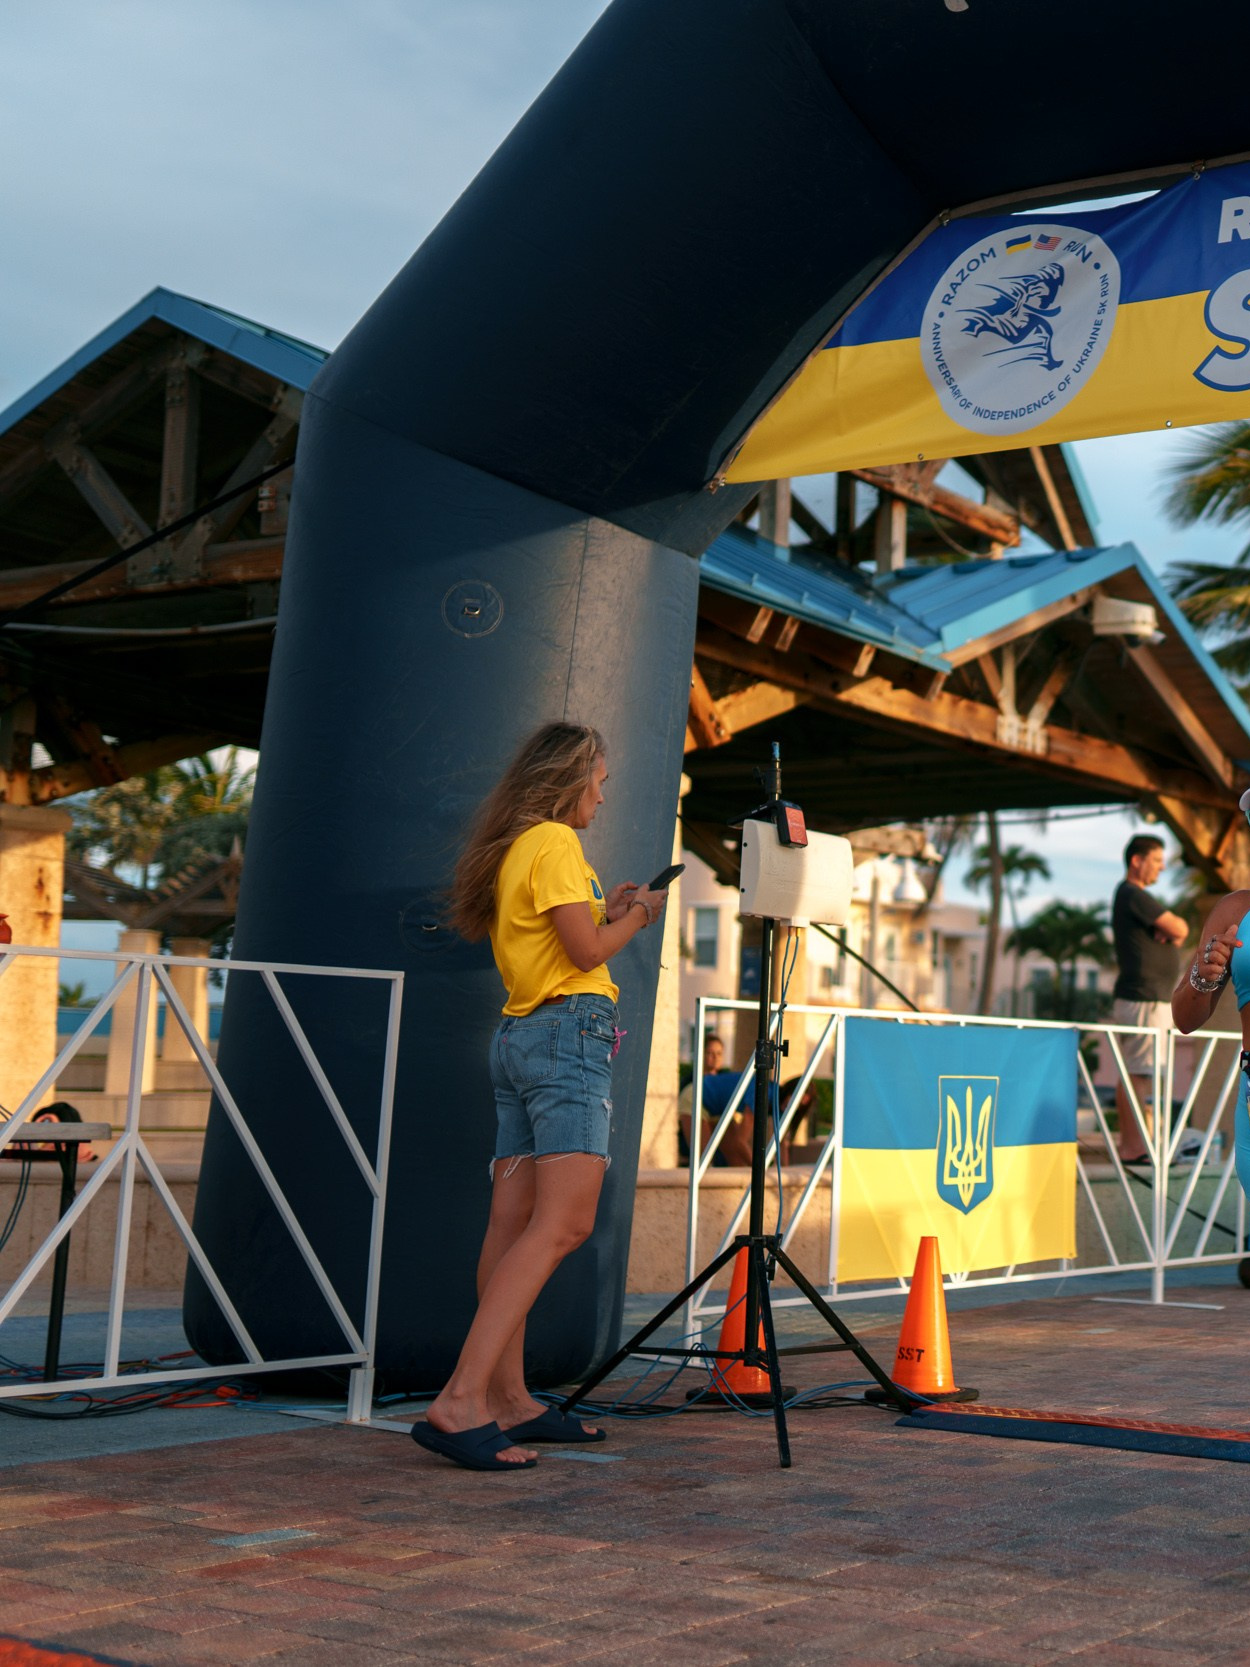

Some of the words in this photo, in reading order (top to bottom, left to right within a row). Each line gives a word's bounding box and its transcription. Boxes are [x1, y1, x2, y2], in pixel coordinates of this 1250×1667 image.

[941, 247, 997, 306] RAZOM
[1062, 240, 1093, 264] RUN
[1099, 273, 1109, 299] RUN
[1096, 299, 1107, 315] 5K
[1072, 318, 1104, 374] UKRAINE
[932, 322, 962, 400] ANNIVERSARY
[1057, 374, 1073, 392] OF
[959, 397, 973, 410] OF
[972, 390, 1057, 421] INDEPENDENCE
[898, 1346, 925, 1363] SST
